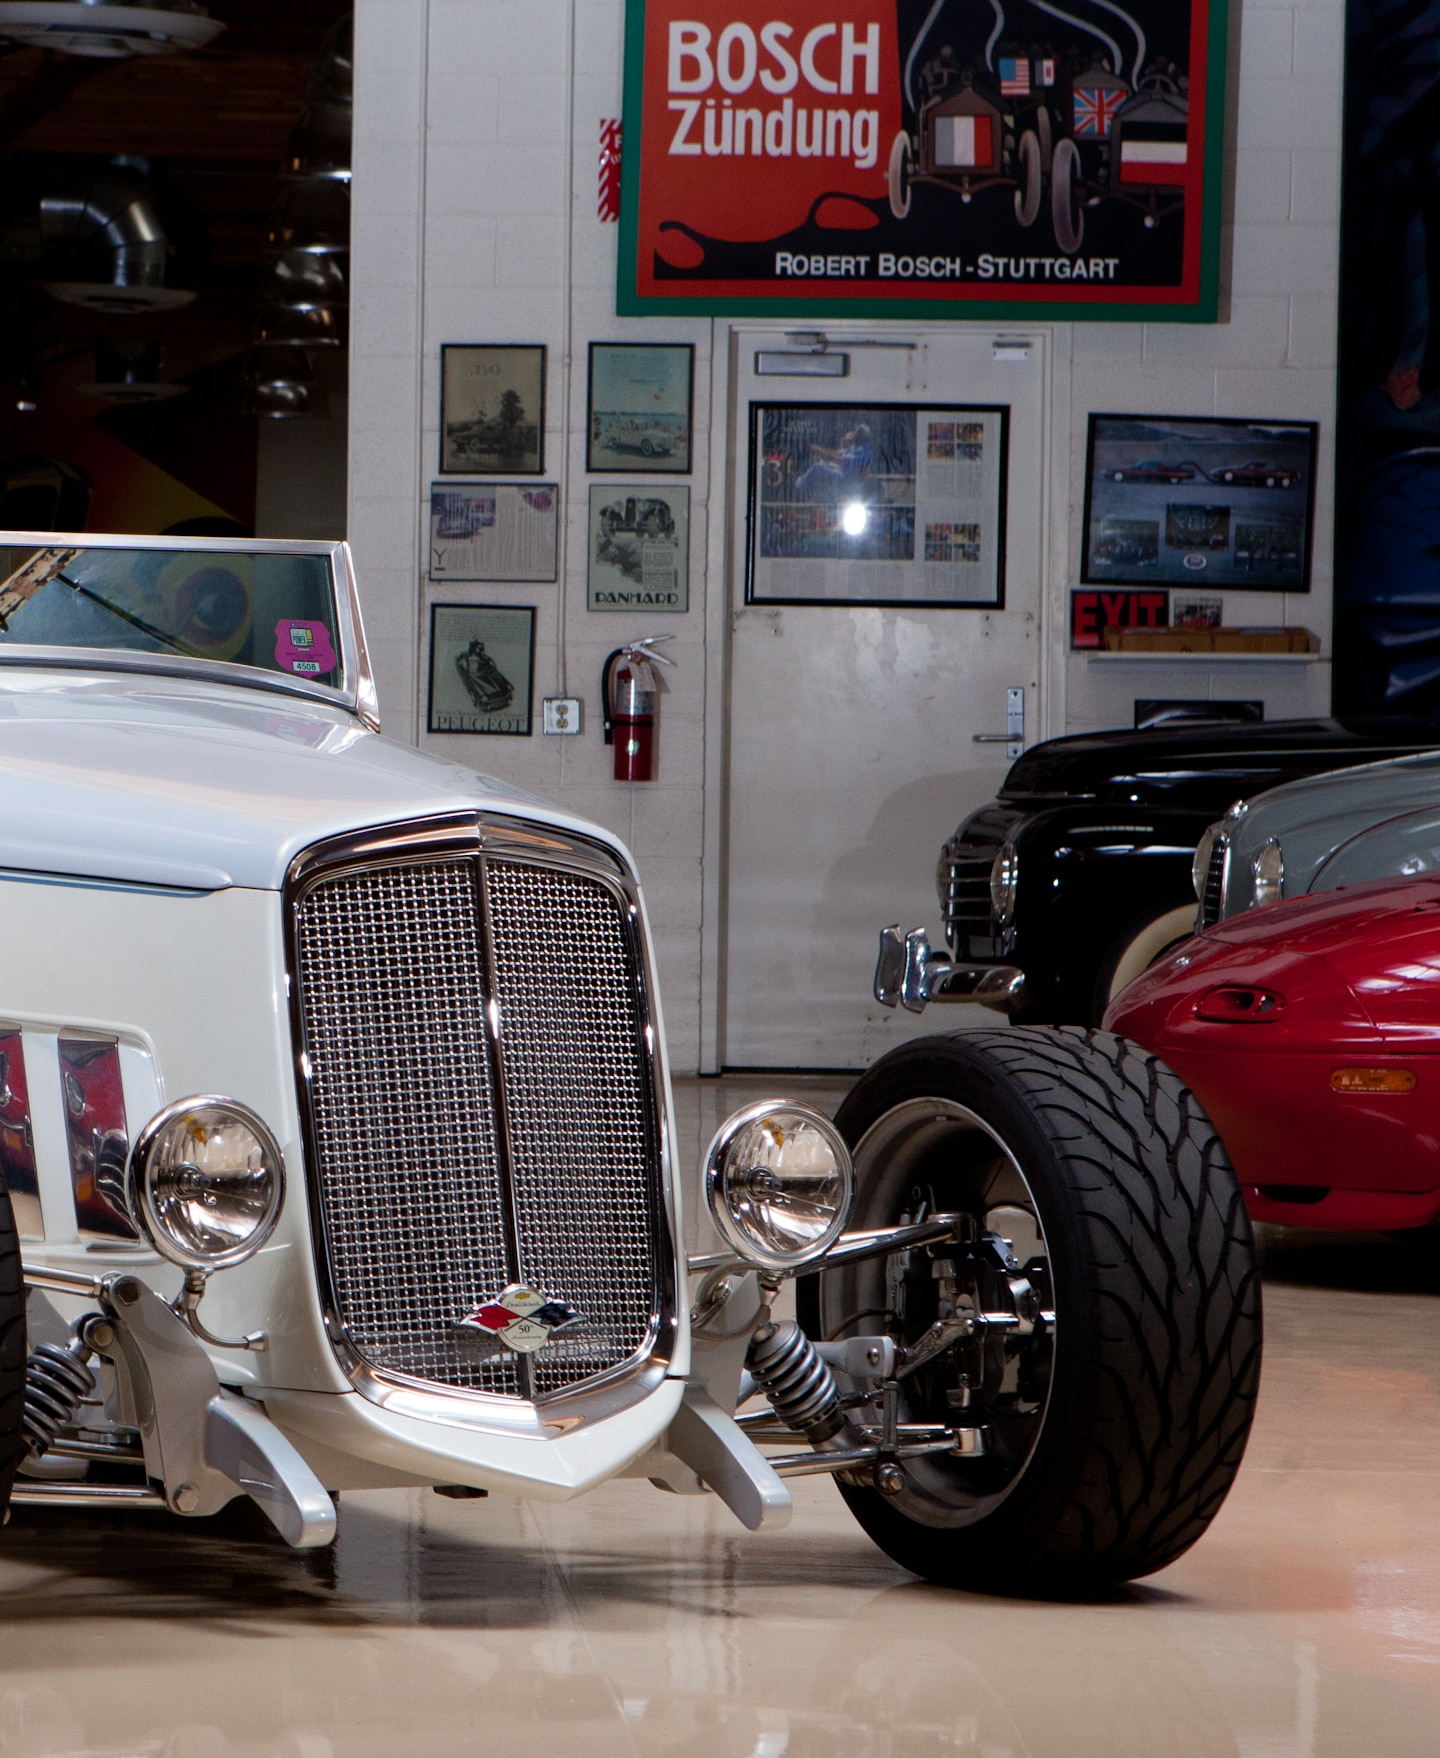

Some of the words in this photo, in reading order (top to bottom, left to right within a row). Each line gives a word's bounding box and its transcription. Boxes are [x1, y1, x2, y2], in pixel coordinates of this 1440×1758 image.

[667, 20, 880, 96] BOSCH
[667, 98, 880, 169] Zündung
[775, 252, 870, 278] ROBERT
[432, 547, 448, 566] Y
[594, 592, 679, 604] PANHARD
[1073, 593, 1165, 647] EXIT
[436, 715, 525, 733] PEUGEOT
